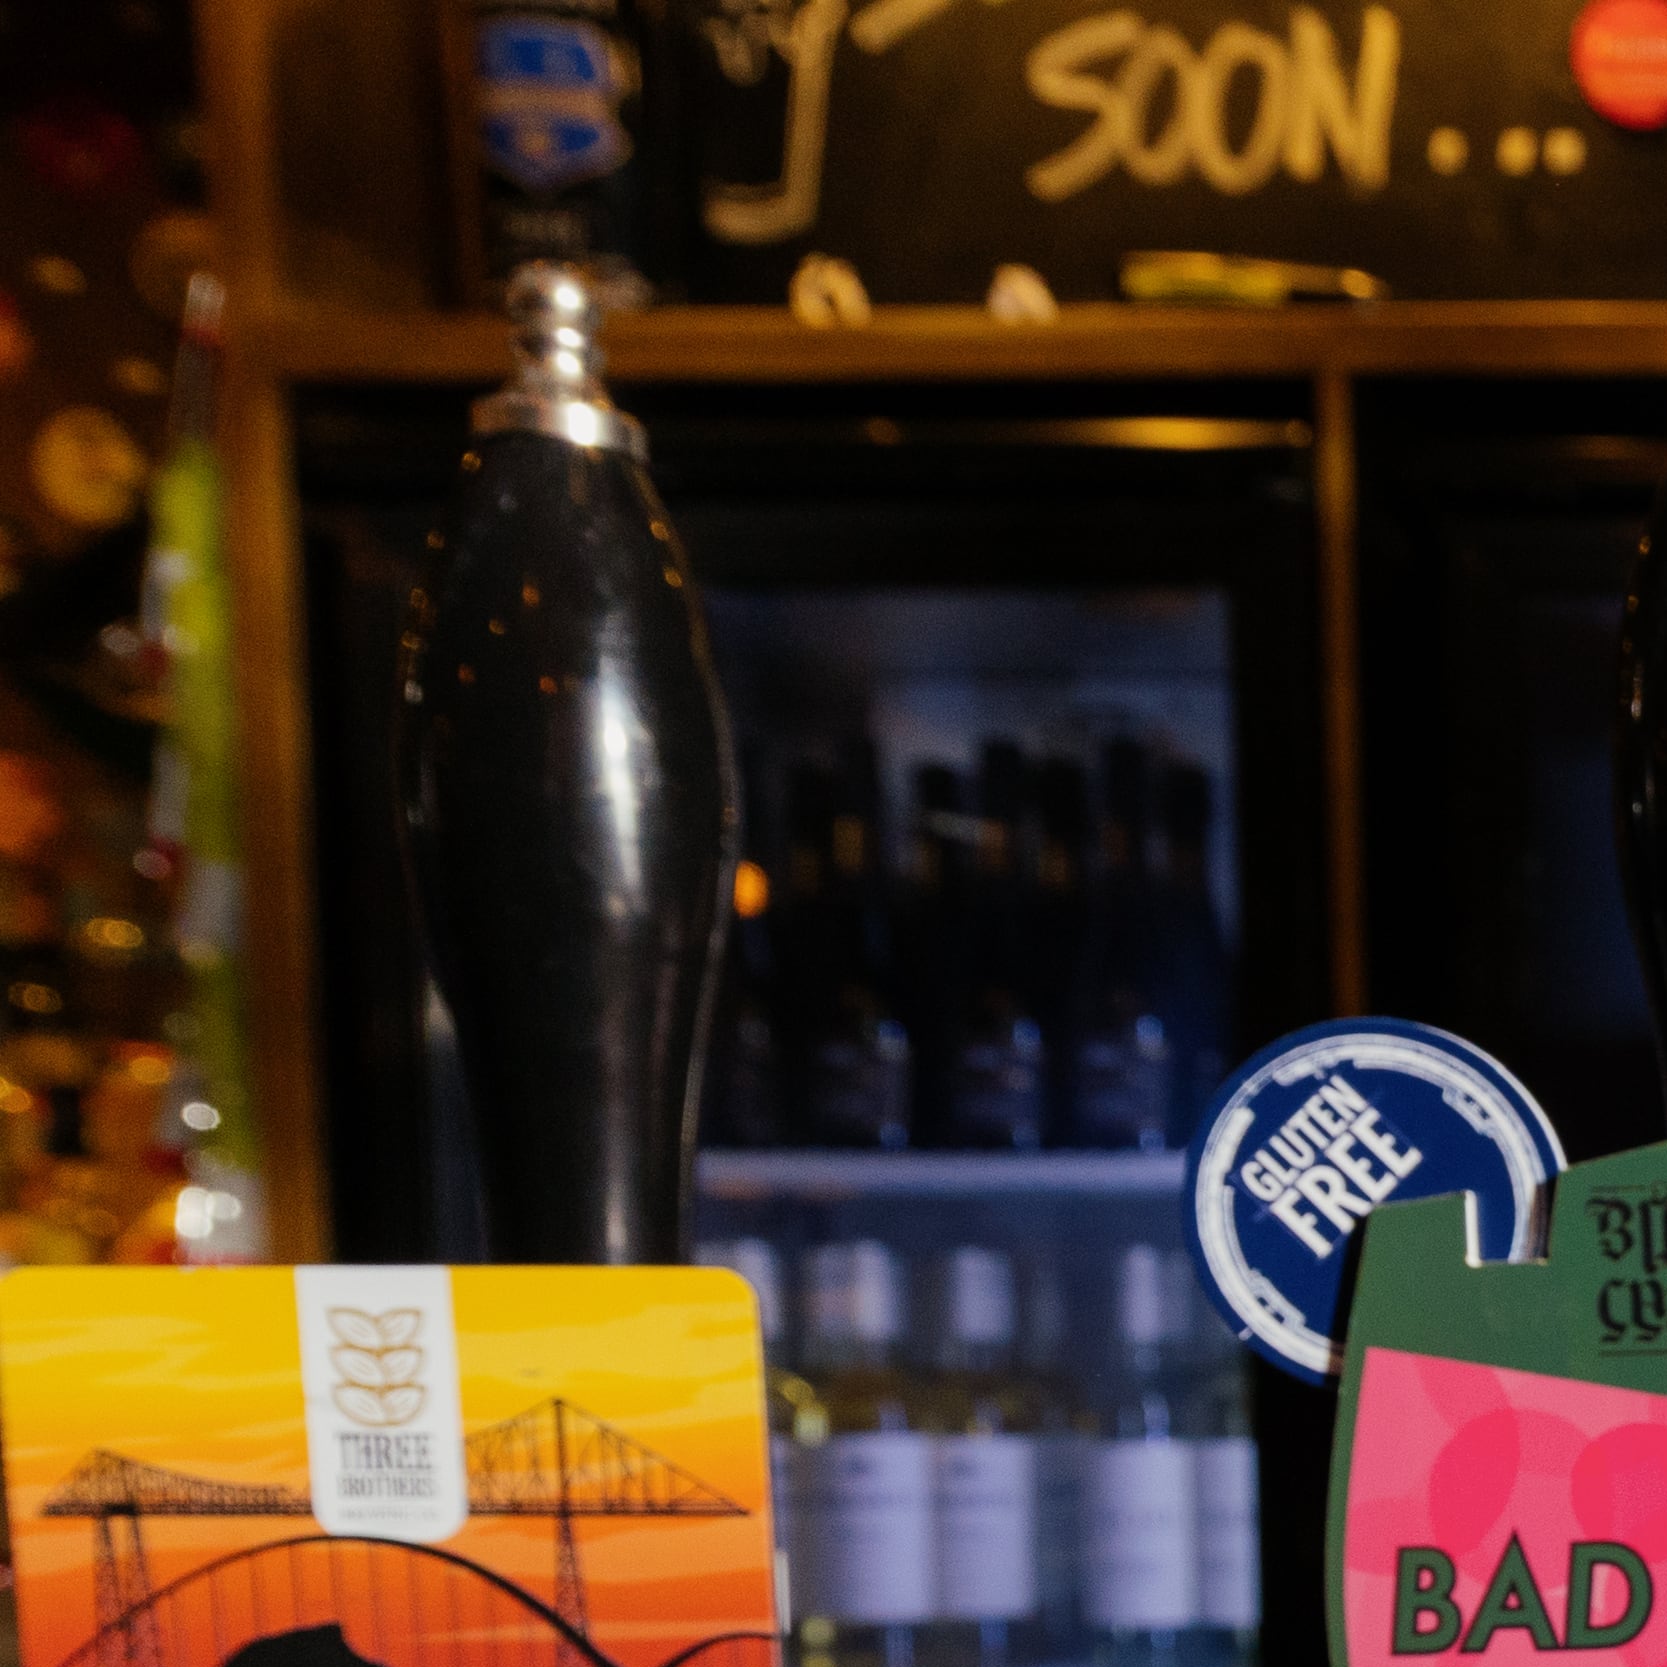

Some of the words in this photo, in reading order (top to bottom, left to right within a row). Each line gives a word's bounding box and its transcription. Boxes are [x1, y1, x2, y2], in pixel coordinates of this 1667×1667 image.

[1240, 1074, 1368, 1202] GLUTEN
[1270, 1106, 1423, 1258] FREE
[338, 1432, 434, 1470] THREE
[1391, 1531, 1654, 1656] BAD
